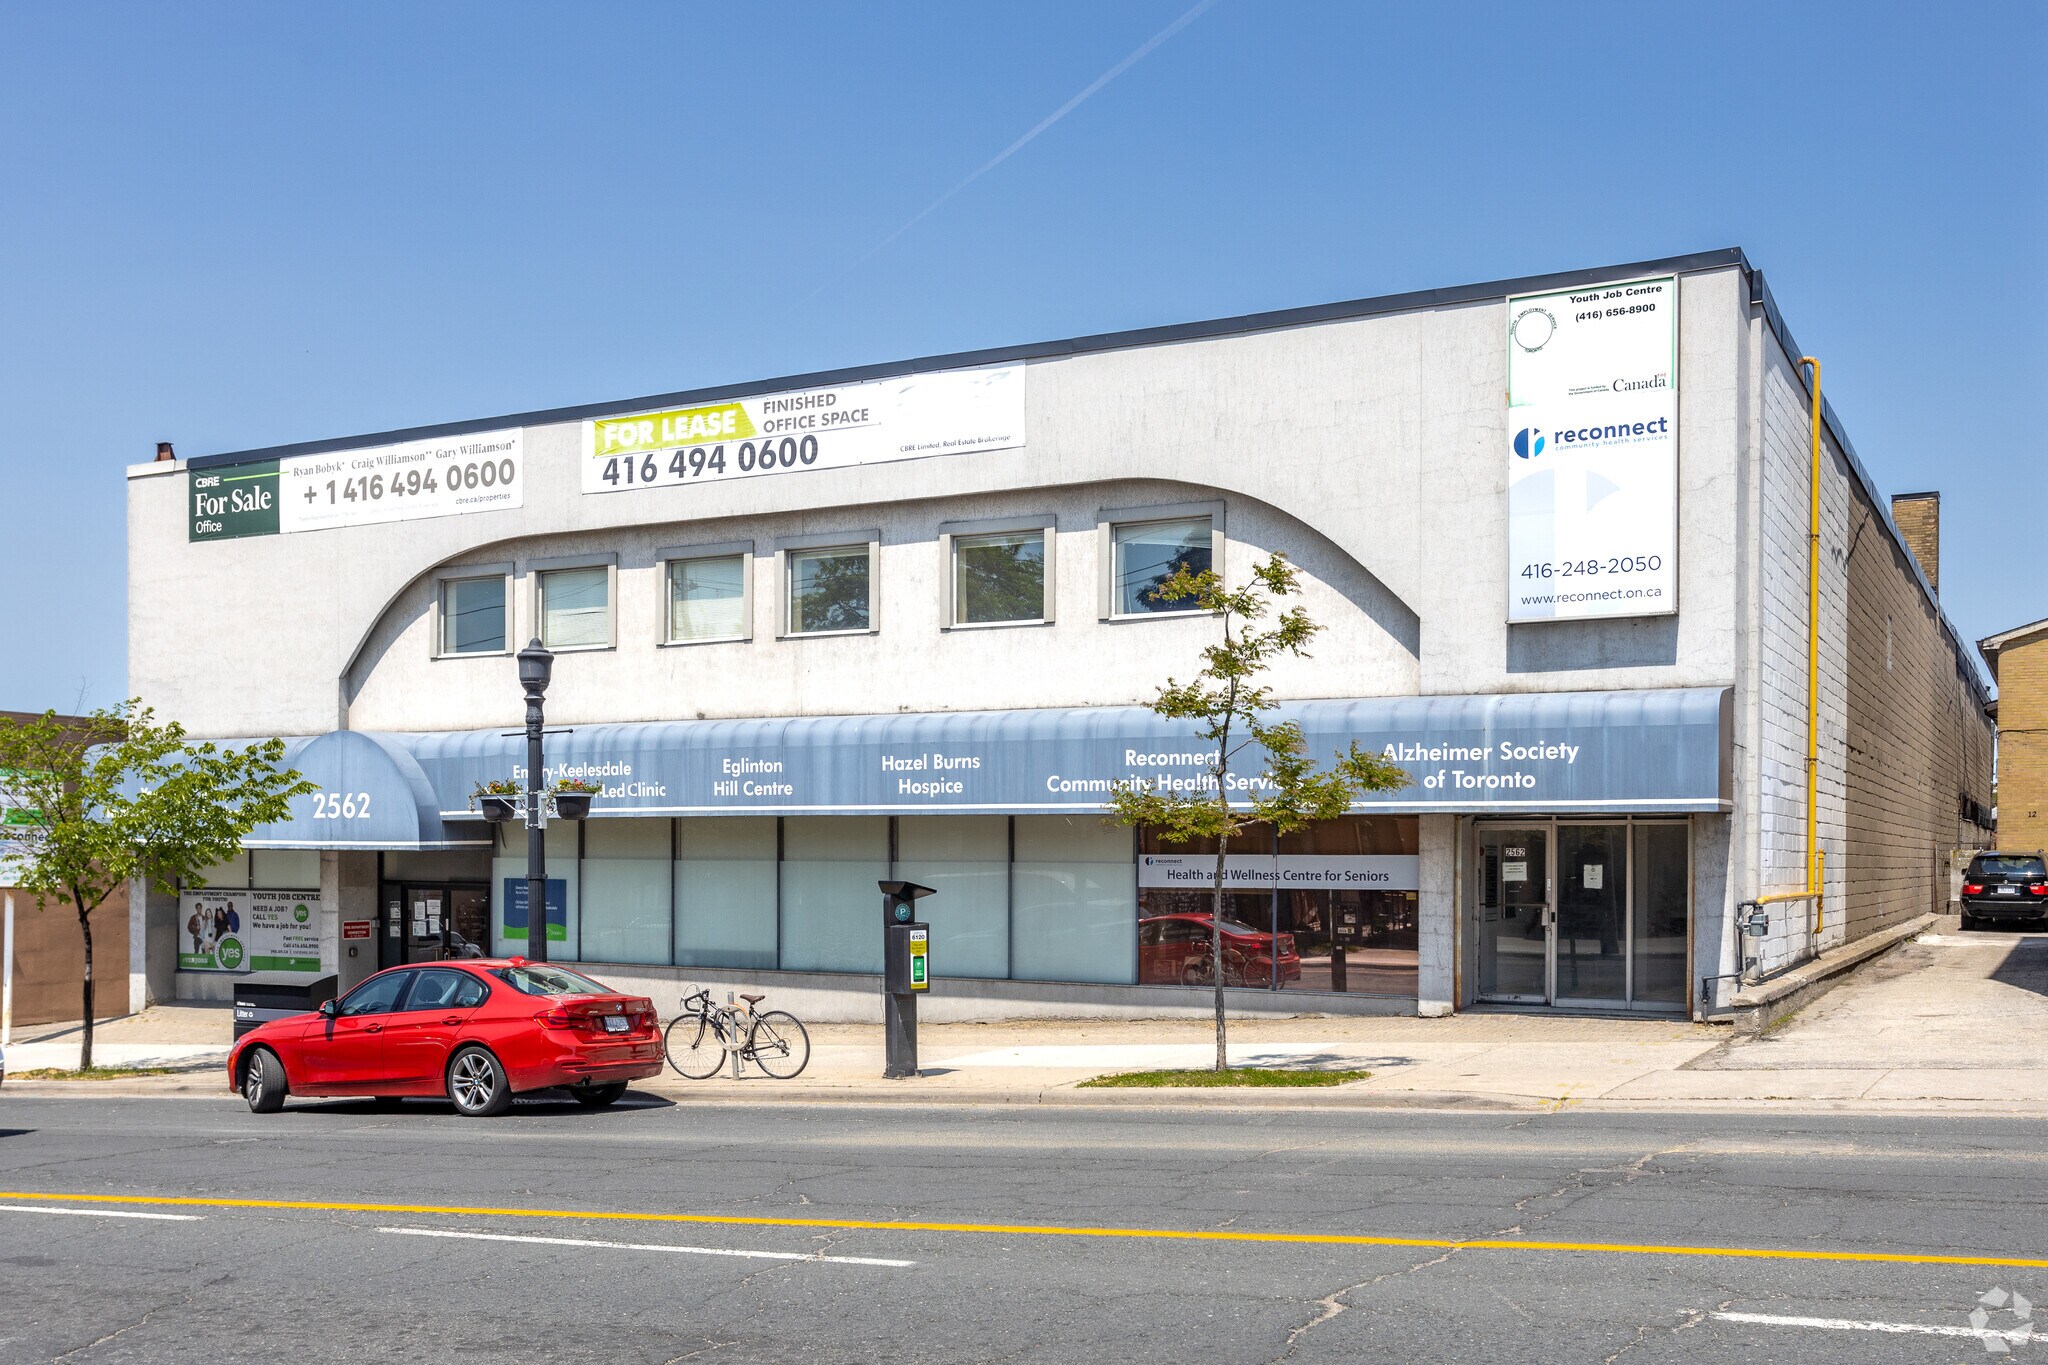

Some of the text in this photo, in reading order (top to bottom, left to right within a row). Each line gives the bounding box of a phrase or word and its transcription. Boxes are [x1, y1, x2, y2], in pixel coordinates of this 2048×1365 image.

[1569, 284, 1662, 304] Youth Job Centre
[1575, 303, 1656, 322] (416) 656-8900
[1612, 374, 1666, 393] Canada
[763, 393, 836, 414] FINISHED
[604, 410, 736, 449] FOR LEASE
[763, 408, 870, 434] OFFICE SPACE
[1554, 416, 1668, 444] reconnect
[958, 438, 976, 446] Estate
[978, 435, 1010, 443] Brokerage
[1555, 434, 1668, 451] community health services
[293, 467, 314, 478] Ryan
[352, 458, 374, 470] Craig
[436, 448, 458, 460] Gary
[602, 434, 818, 486] 416 494 0600
[195, 476, 220, 488] CBRE
[304, 458, 515, 504] + 1 416 494 0600
[195, 485, 272, 517] For Sale
[455, 492, 511, 506] cbre.ca/properties
[196, 520, 222, 534] Office
[1521, 555, 1662, 580] 416-248-2050
[1521, 588, 1662, 605] www.reconnect.on.ca
[1125, 749, 1220, 766] Reconnect
[1382, 740, 1580, 764] Alzheimer Society
[513, 760, 632, 782] Emry-Keelesdale
[722, 758, 783, 777] Eglinton
[882, 754, 980, 771] Hazel Burns
[714, 780, 794, 796] Hill Centre
[898, 776, 964, 798] Hospice
[1046, 772, 1304, 795] Community Health Servics
[1424, 769, 1536, 789] of Toronto
[627, 781, 666, 797] Clinic
[312, 792, 370, 819] 2562
[1506, 848, 1525, 856] 2562
[1167, 869, 1204, 880] Health
[1230, 870, 1280, 881] Wellness
[1283, 870, 1322, 881] Centre
[1325, 869, 1342, 881] for
[1344, 870, 1389, 882] Seniors
[280, 922, 289, 930] job
[222, 948, 240, 961] yes
